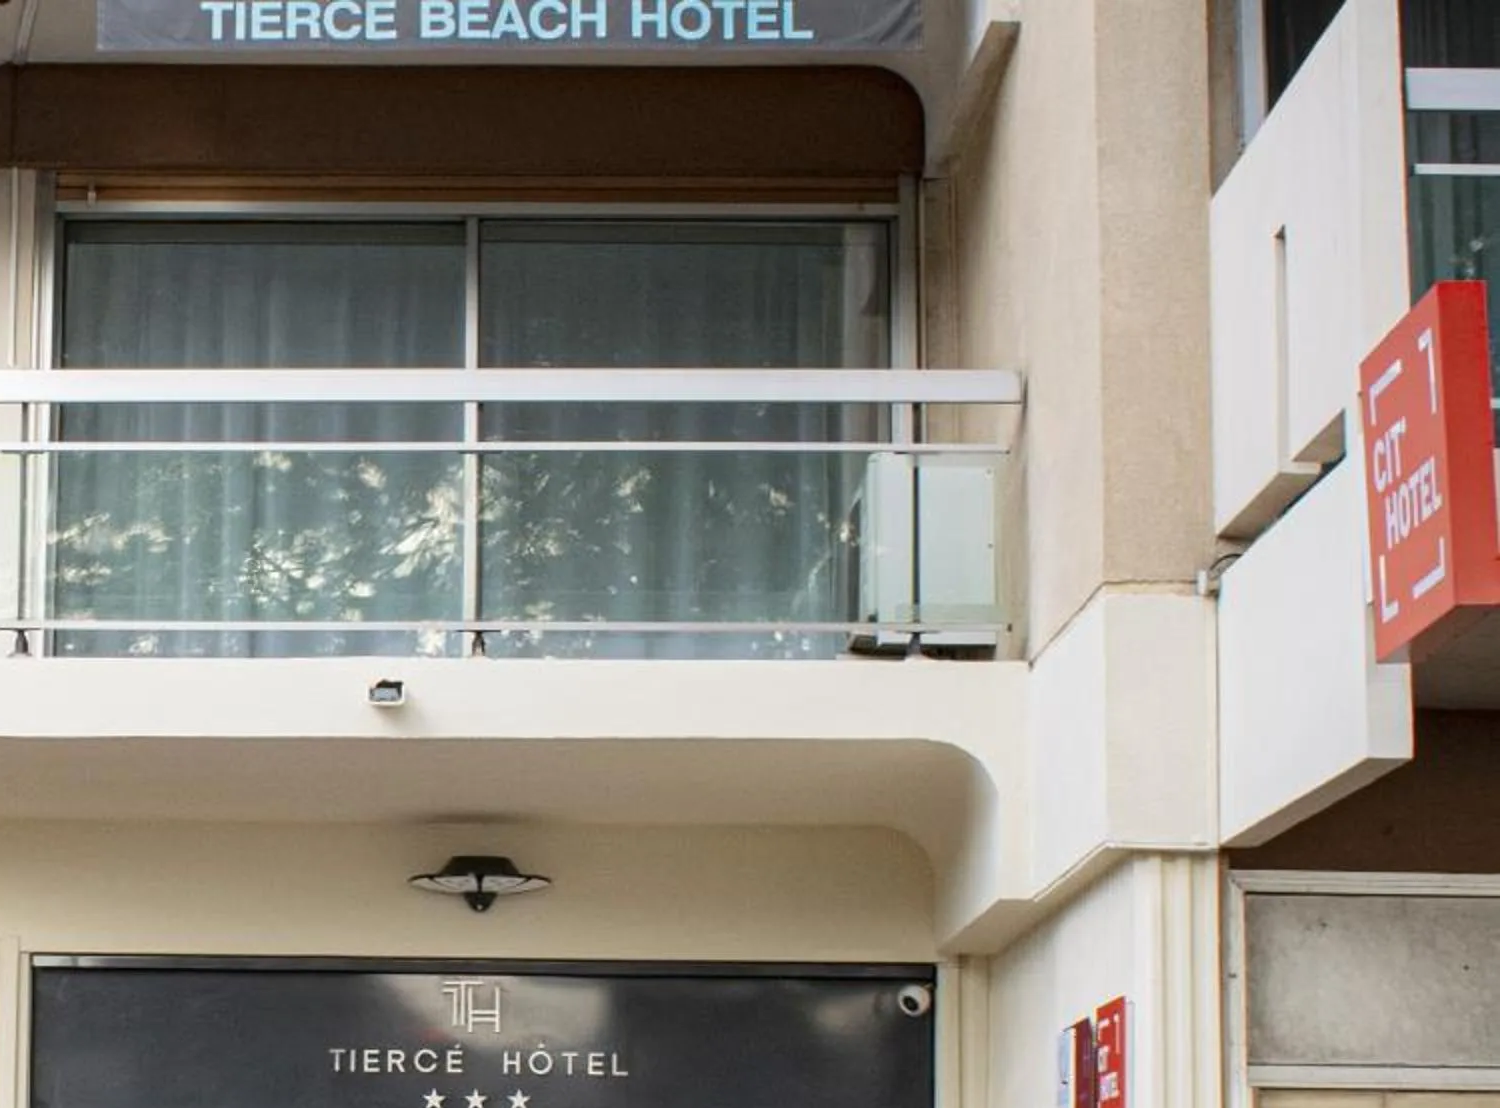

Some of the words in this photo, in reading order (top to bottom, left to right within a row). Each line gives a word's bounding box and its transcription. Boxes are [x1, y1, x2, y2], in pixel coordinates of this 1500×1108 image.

[201, 0, 398, 41] TIERCE
[420, 0, 607, 41] BEACH
[631, 0, 815, 40] HOTEL
[1384, 456, 1443, 552] HOTEL
[329, 1043, 464, 1074] TIERCÉ
[502, 1042, 629, 1077] HÔTEL
